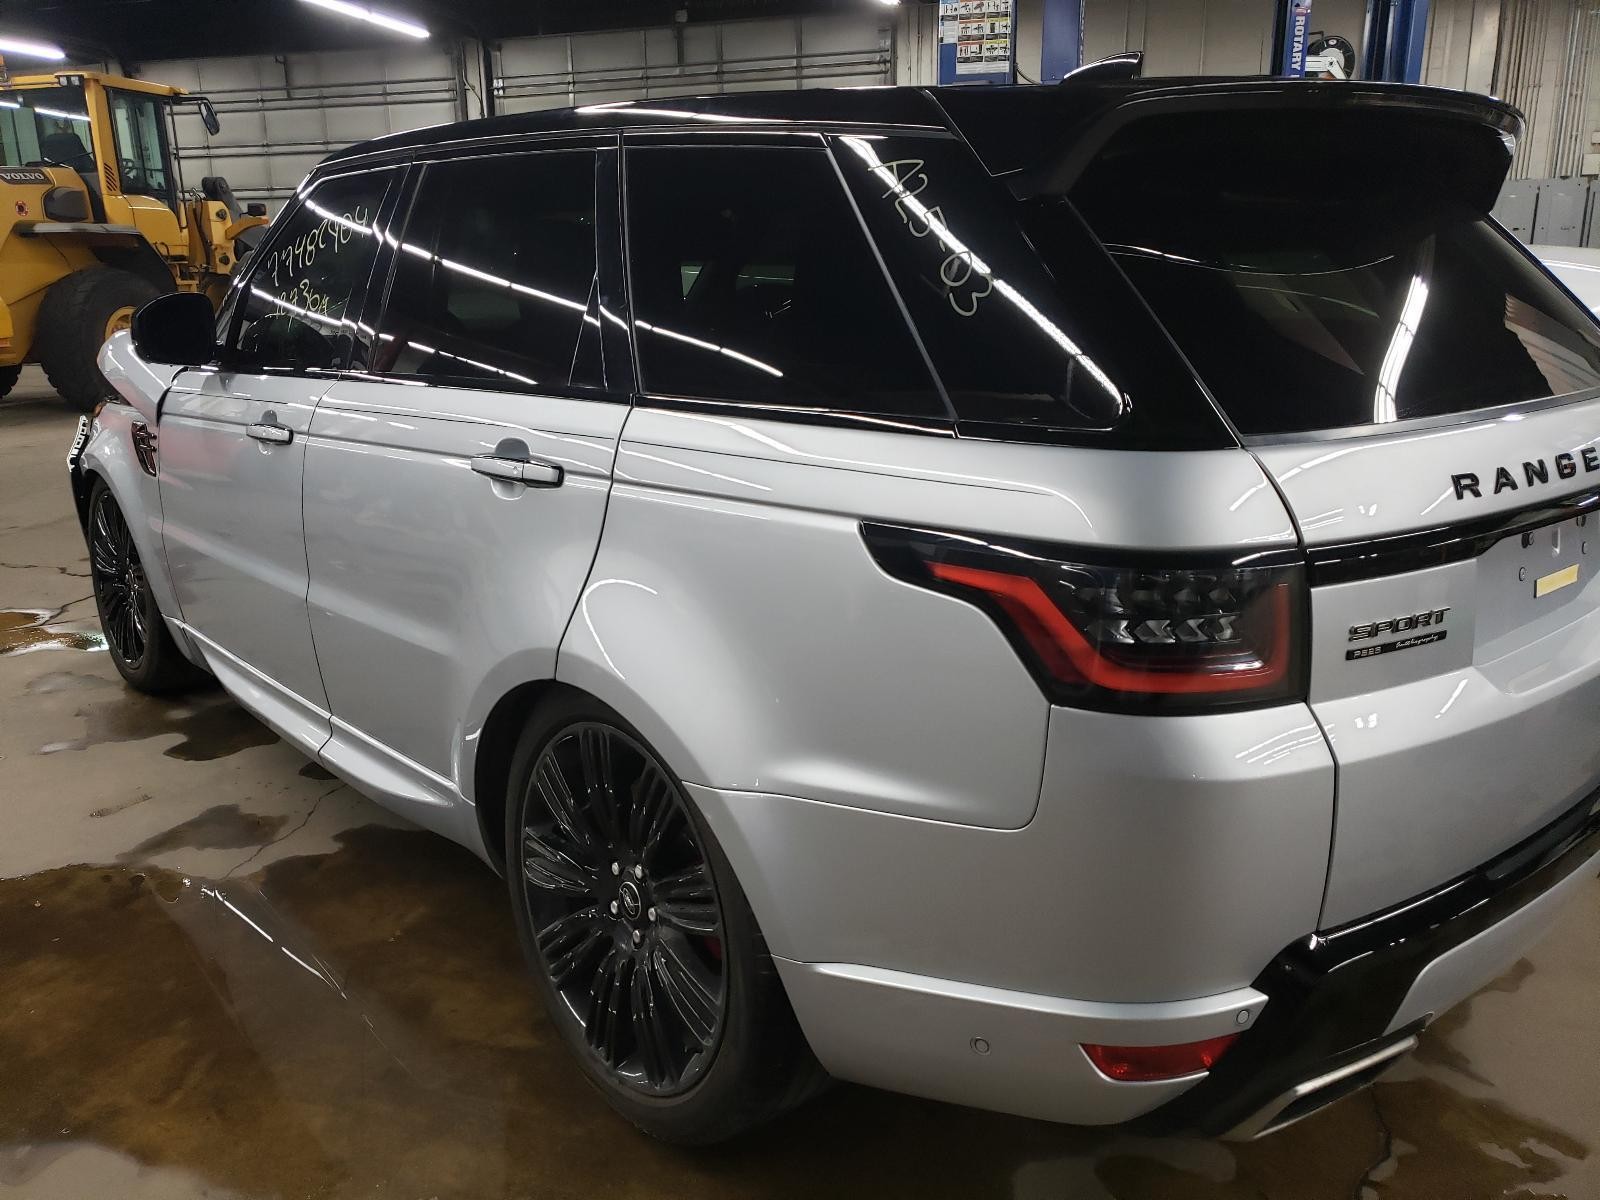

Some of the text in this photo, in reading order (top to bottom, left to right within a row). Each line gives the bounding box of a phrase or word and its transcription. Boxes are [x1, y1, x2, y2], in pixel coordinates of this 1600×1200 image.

[1291, 15, 1306, 71] ROTARY
[0, 172, 45, 180] VOLVO
[1451, 446, 1600, 501] RANGE
[1348, 606, 1451, 642] SPORT
[1353, 646, 1382, 660] P525
